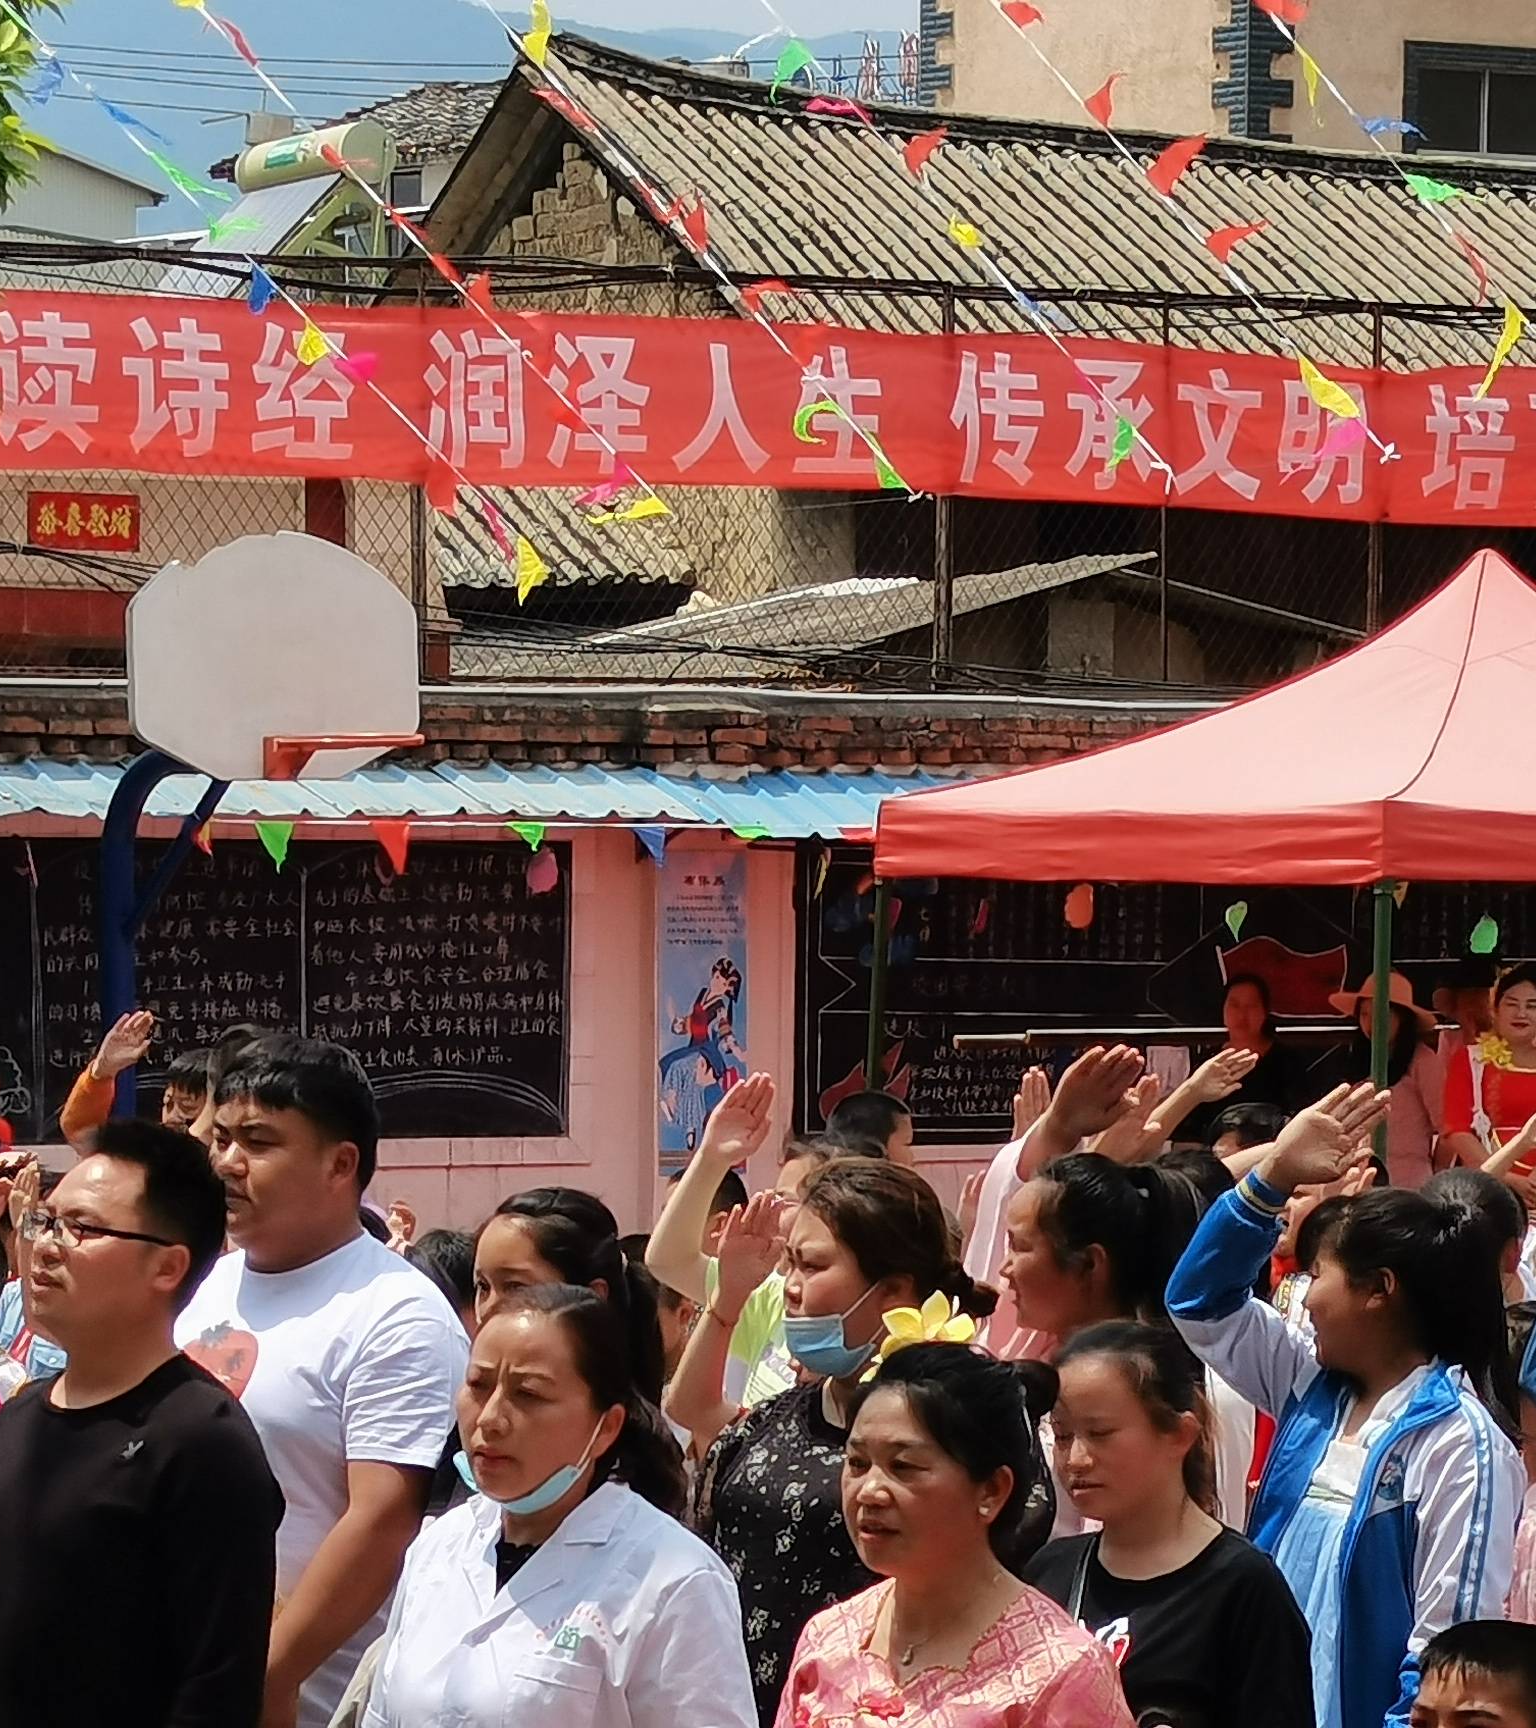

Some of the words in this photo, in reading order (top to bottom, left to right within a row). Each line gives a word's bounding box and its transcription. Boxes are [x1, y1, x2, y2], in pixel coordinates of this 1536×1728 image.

[425, 326, 881, 477] 润泽人生
[950, 350, 1366, 505] 传承文明
